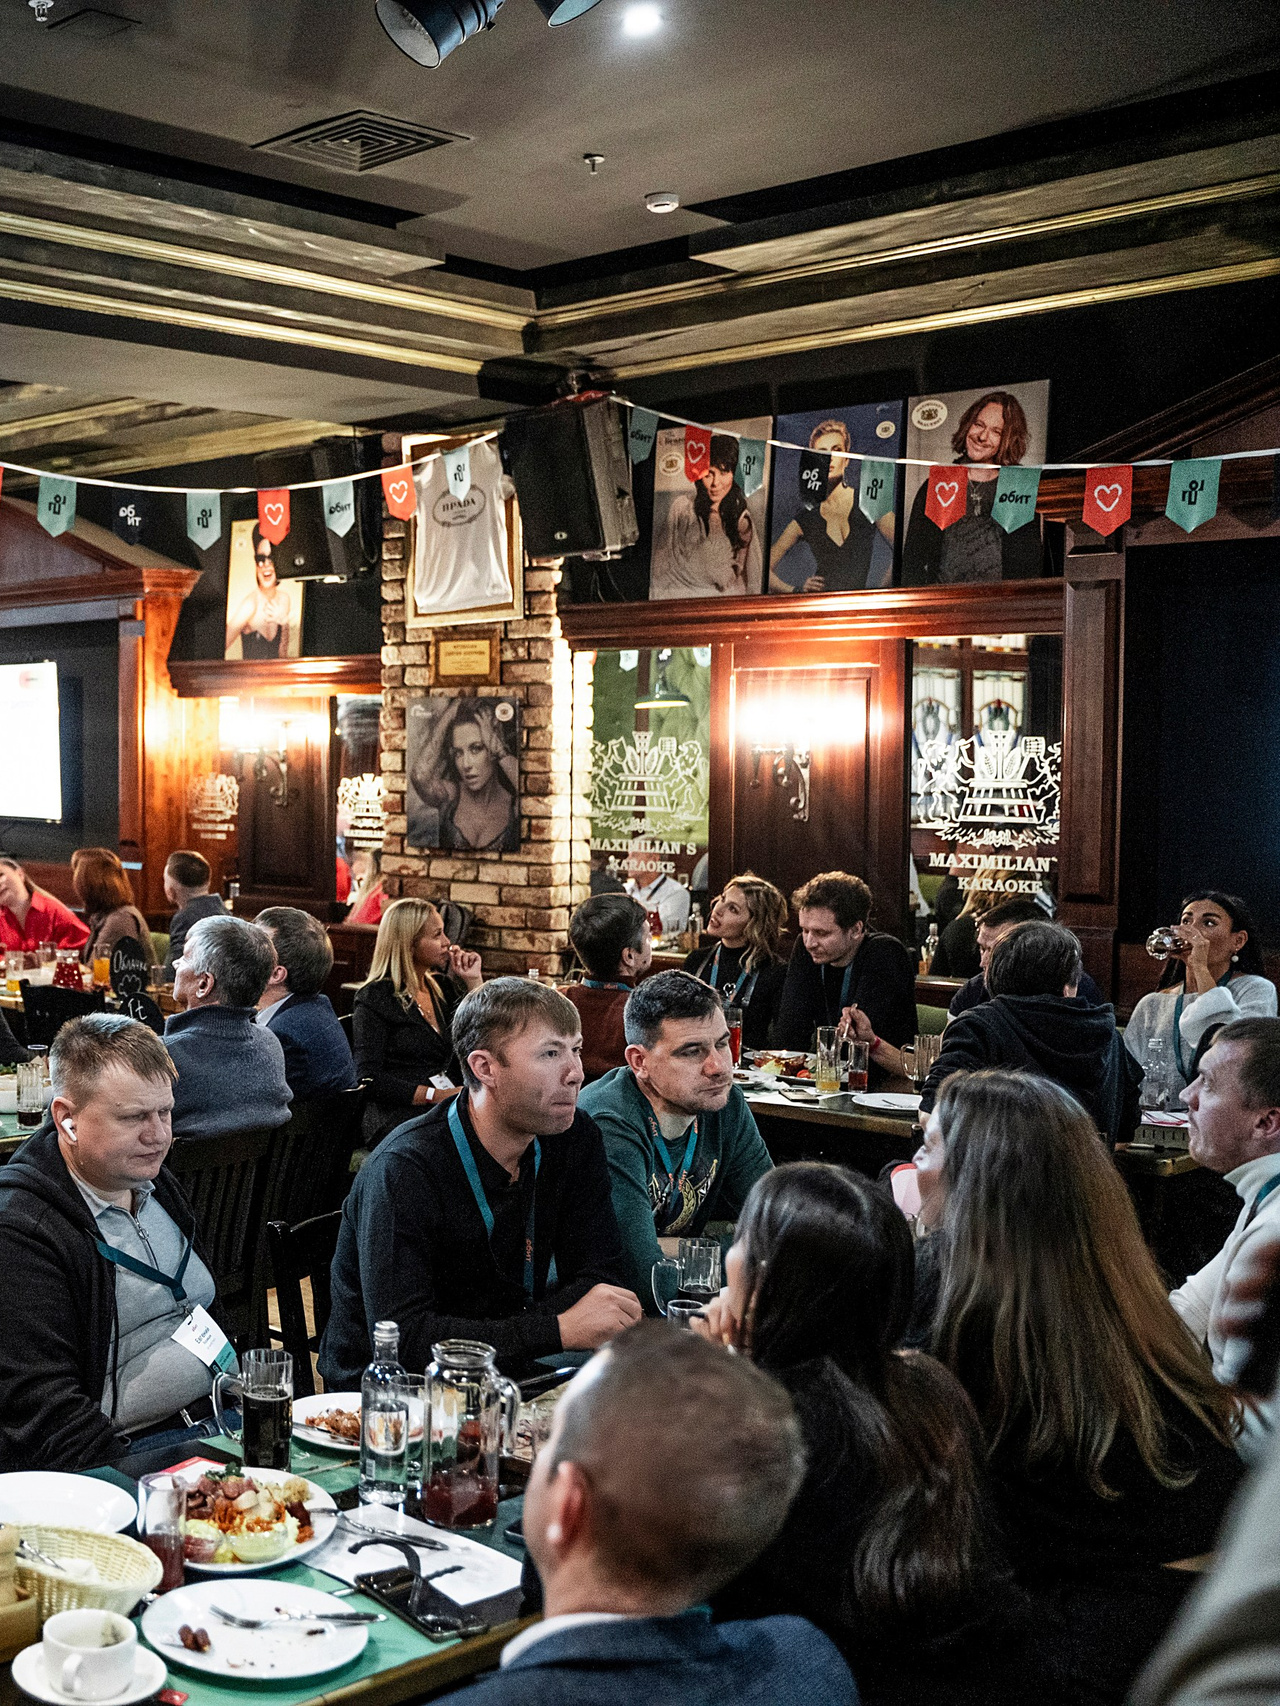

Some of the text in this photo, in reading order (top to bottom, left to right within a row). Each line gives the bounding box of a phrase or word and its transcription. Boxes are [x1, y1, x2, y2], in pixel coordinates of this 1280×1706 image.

[998, 491, 1031, 505] обит
[328, 498, 351, 515] обит
[610, 858, 675, 873] KARAOKE
[957, 877, 1043, 894] KARAOKE
